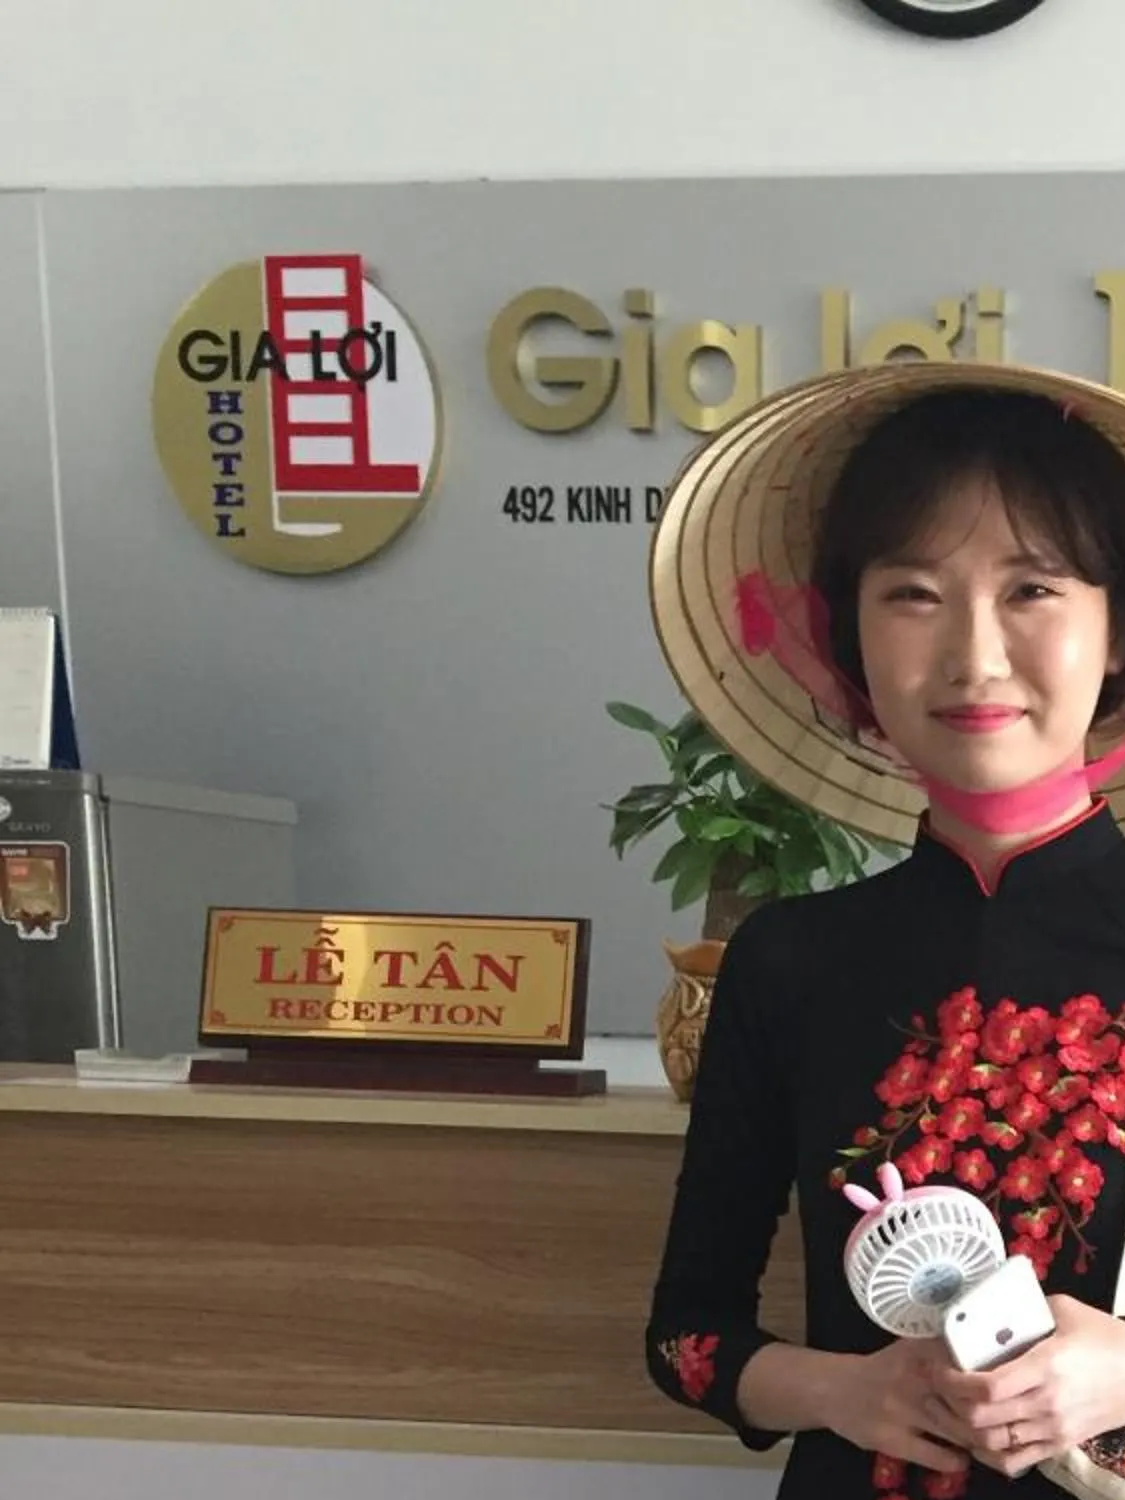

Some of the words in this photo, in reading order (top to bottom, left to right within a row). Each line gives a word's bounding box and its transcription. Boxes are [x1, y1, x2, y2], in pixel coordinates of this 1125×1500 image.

[178, 329, 291, 383] GIA
[486, 285, 764, 434] Gia
[205, 391, 246, 538] HOTEL
[502, 485, 556, 524] 492
[566, 485, 632, 524] KINH
[254, 926, 345, 986] LỄ
[373, 940, 526, 993] TÂN
[267, 997, 506, 1027] RECEPTION
